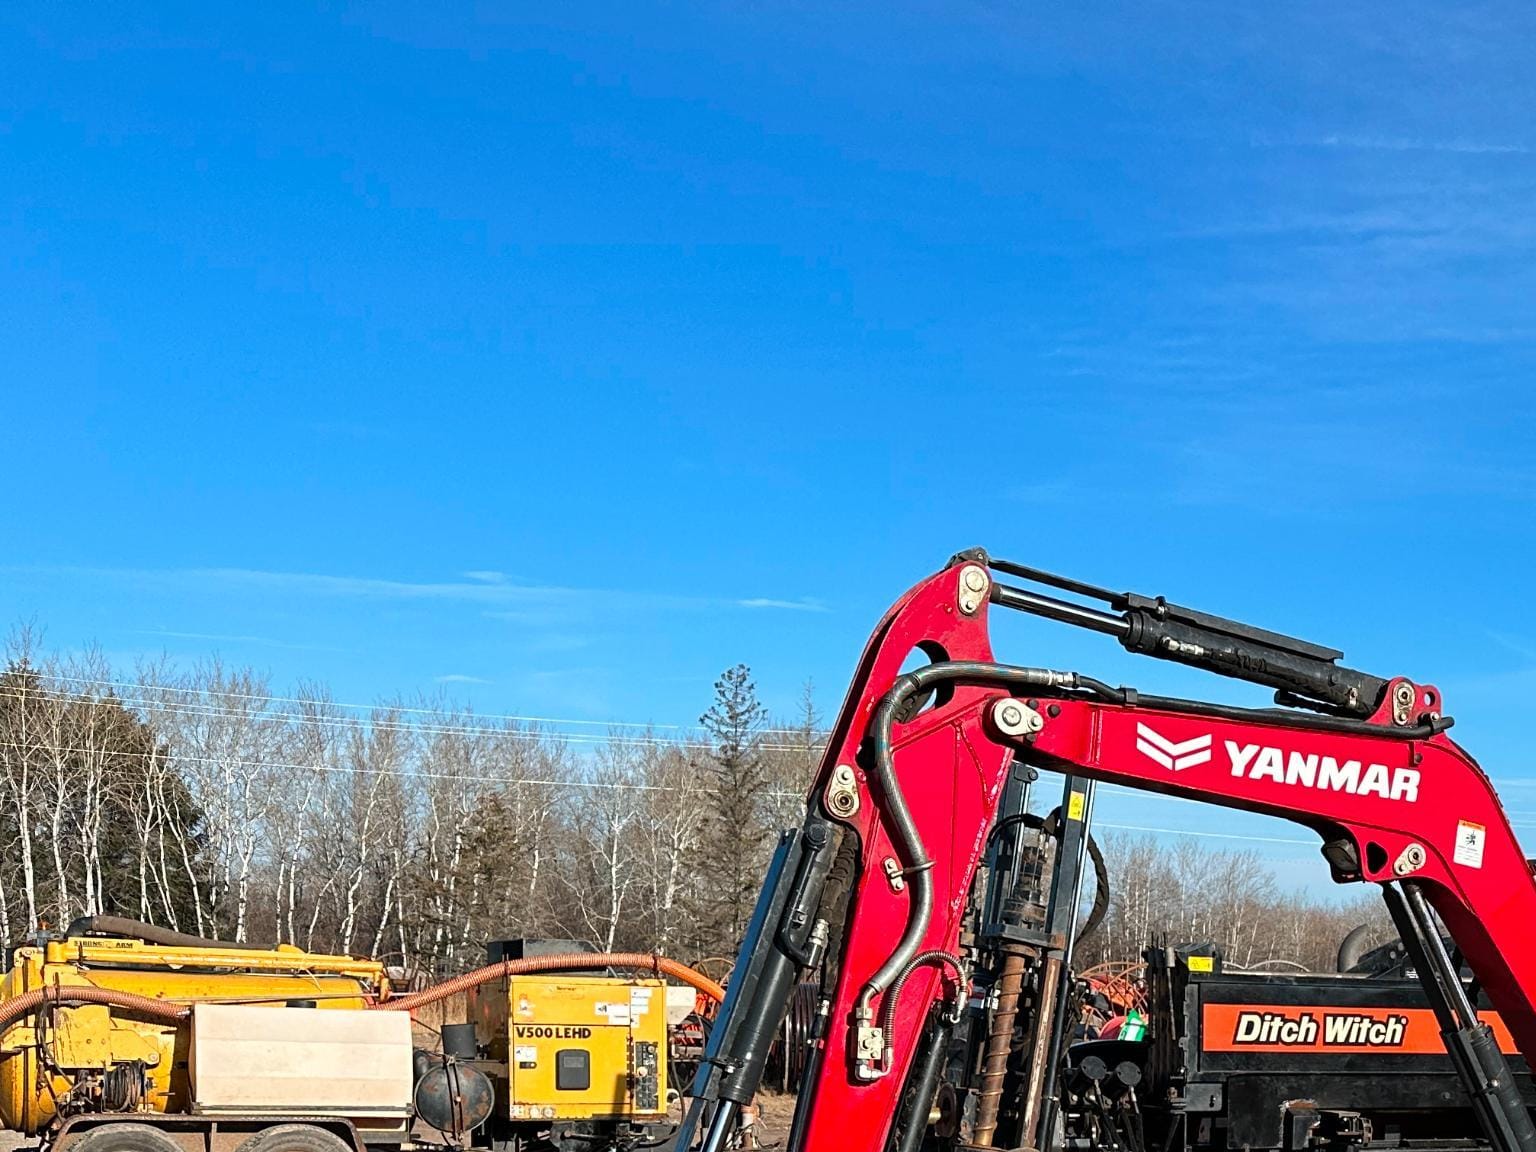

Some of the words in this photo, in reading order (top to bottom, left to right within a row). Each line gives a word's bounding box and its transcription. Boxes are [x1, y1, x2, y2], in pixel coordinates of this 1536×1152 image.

[1224, 740, 1420, 803] YANMAR
[516, 1026, 553, 1038] V500
[555, 1027, 592, 1039] LEHD
[1234, 1013, 1318, 1044] Ditch
[1324, 1014, 1406, 1045] Witch
